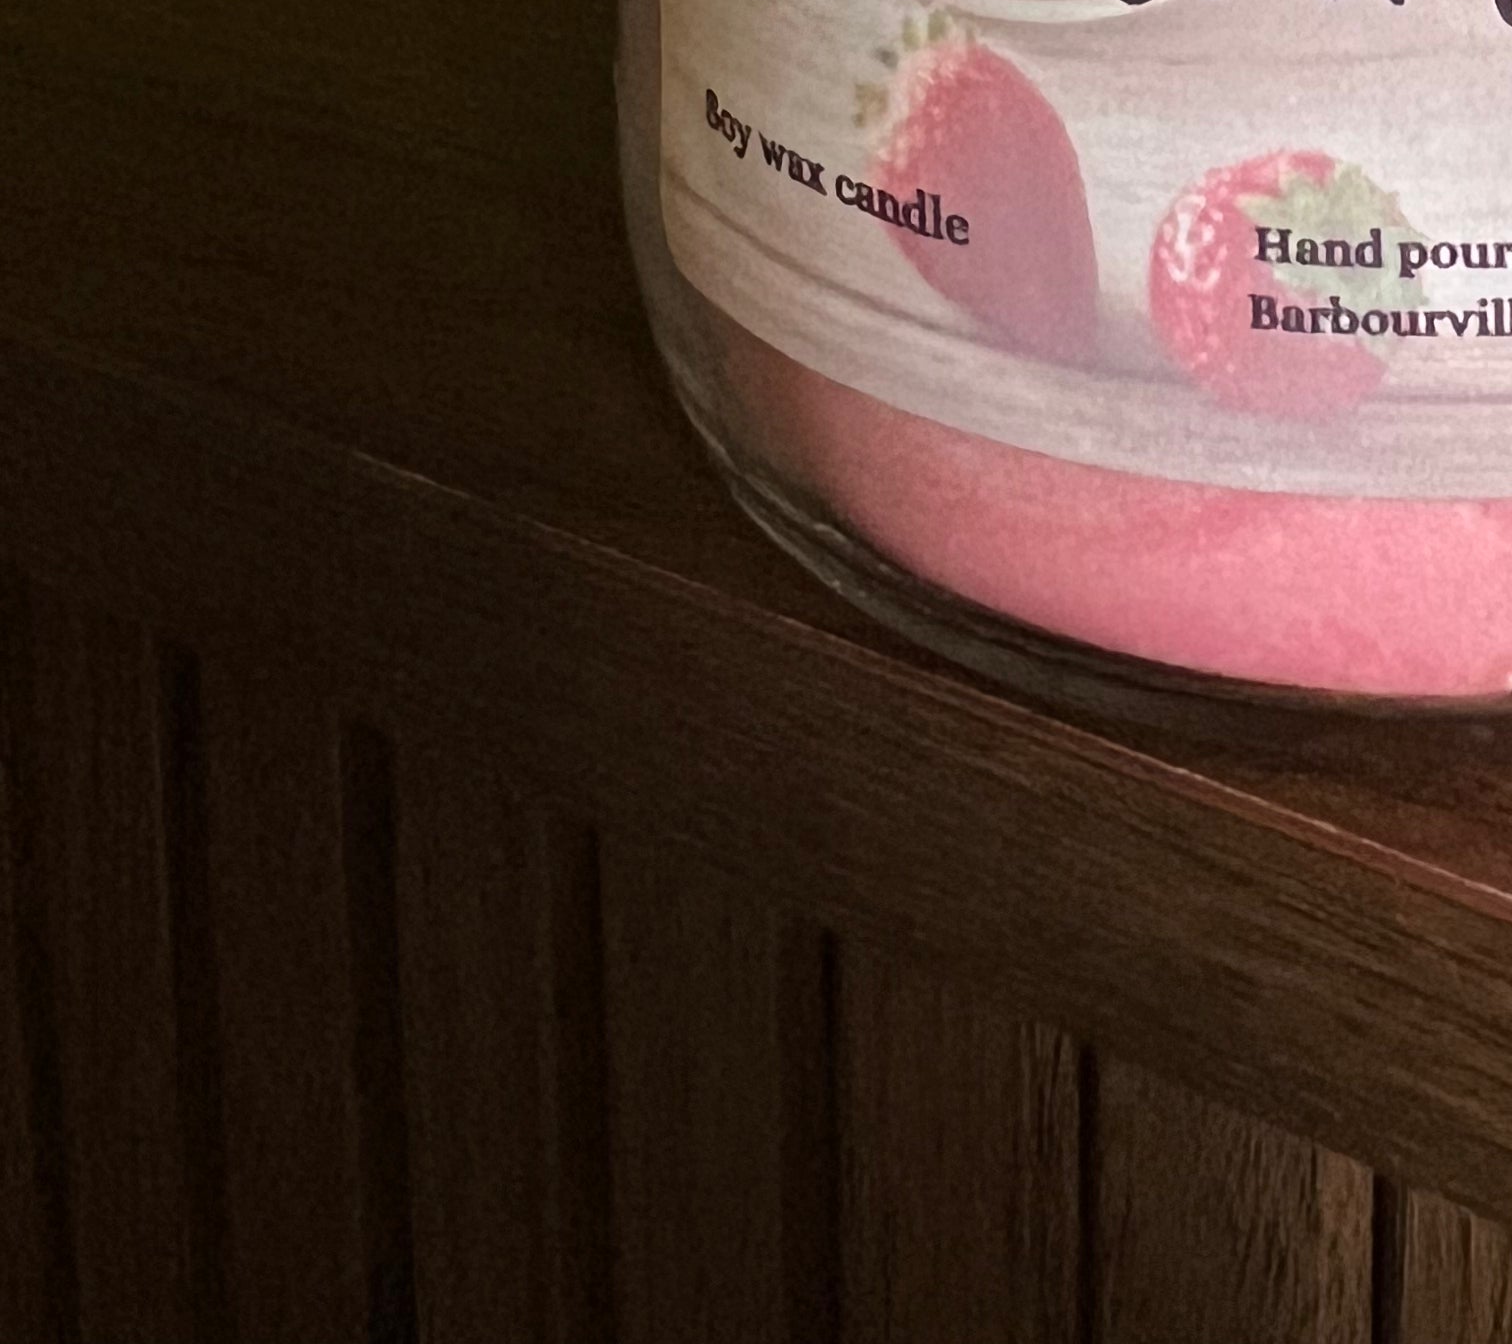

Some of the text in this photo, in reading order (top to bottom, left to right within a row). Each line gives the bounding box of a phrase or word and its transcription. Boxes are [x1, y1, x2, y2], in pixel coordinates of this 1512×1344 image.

[705, 89, 970, 244] Soy wax candle
[1254, 226, 1383, 268] Hand
